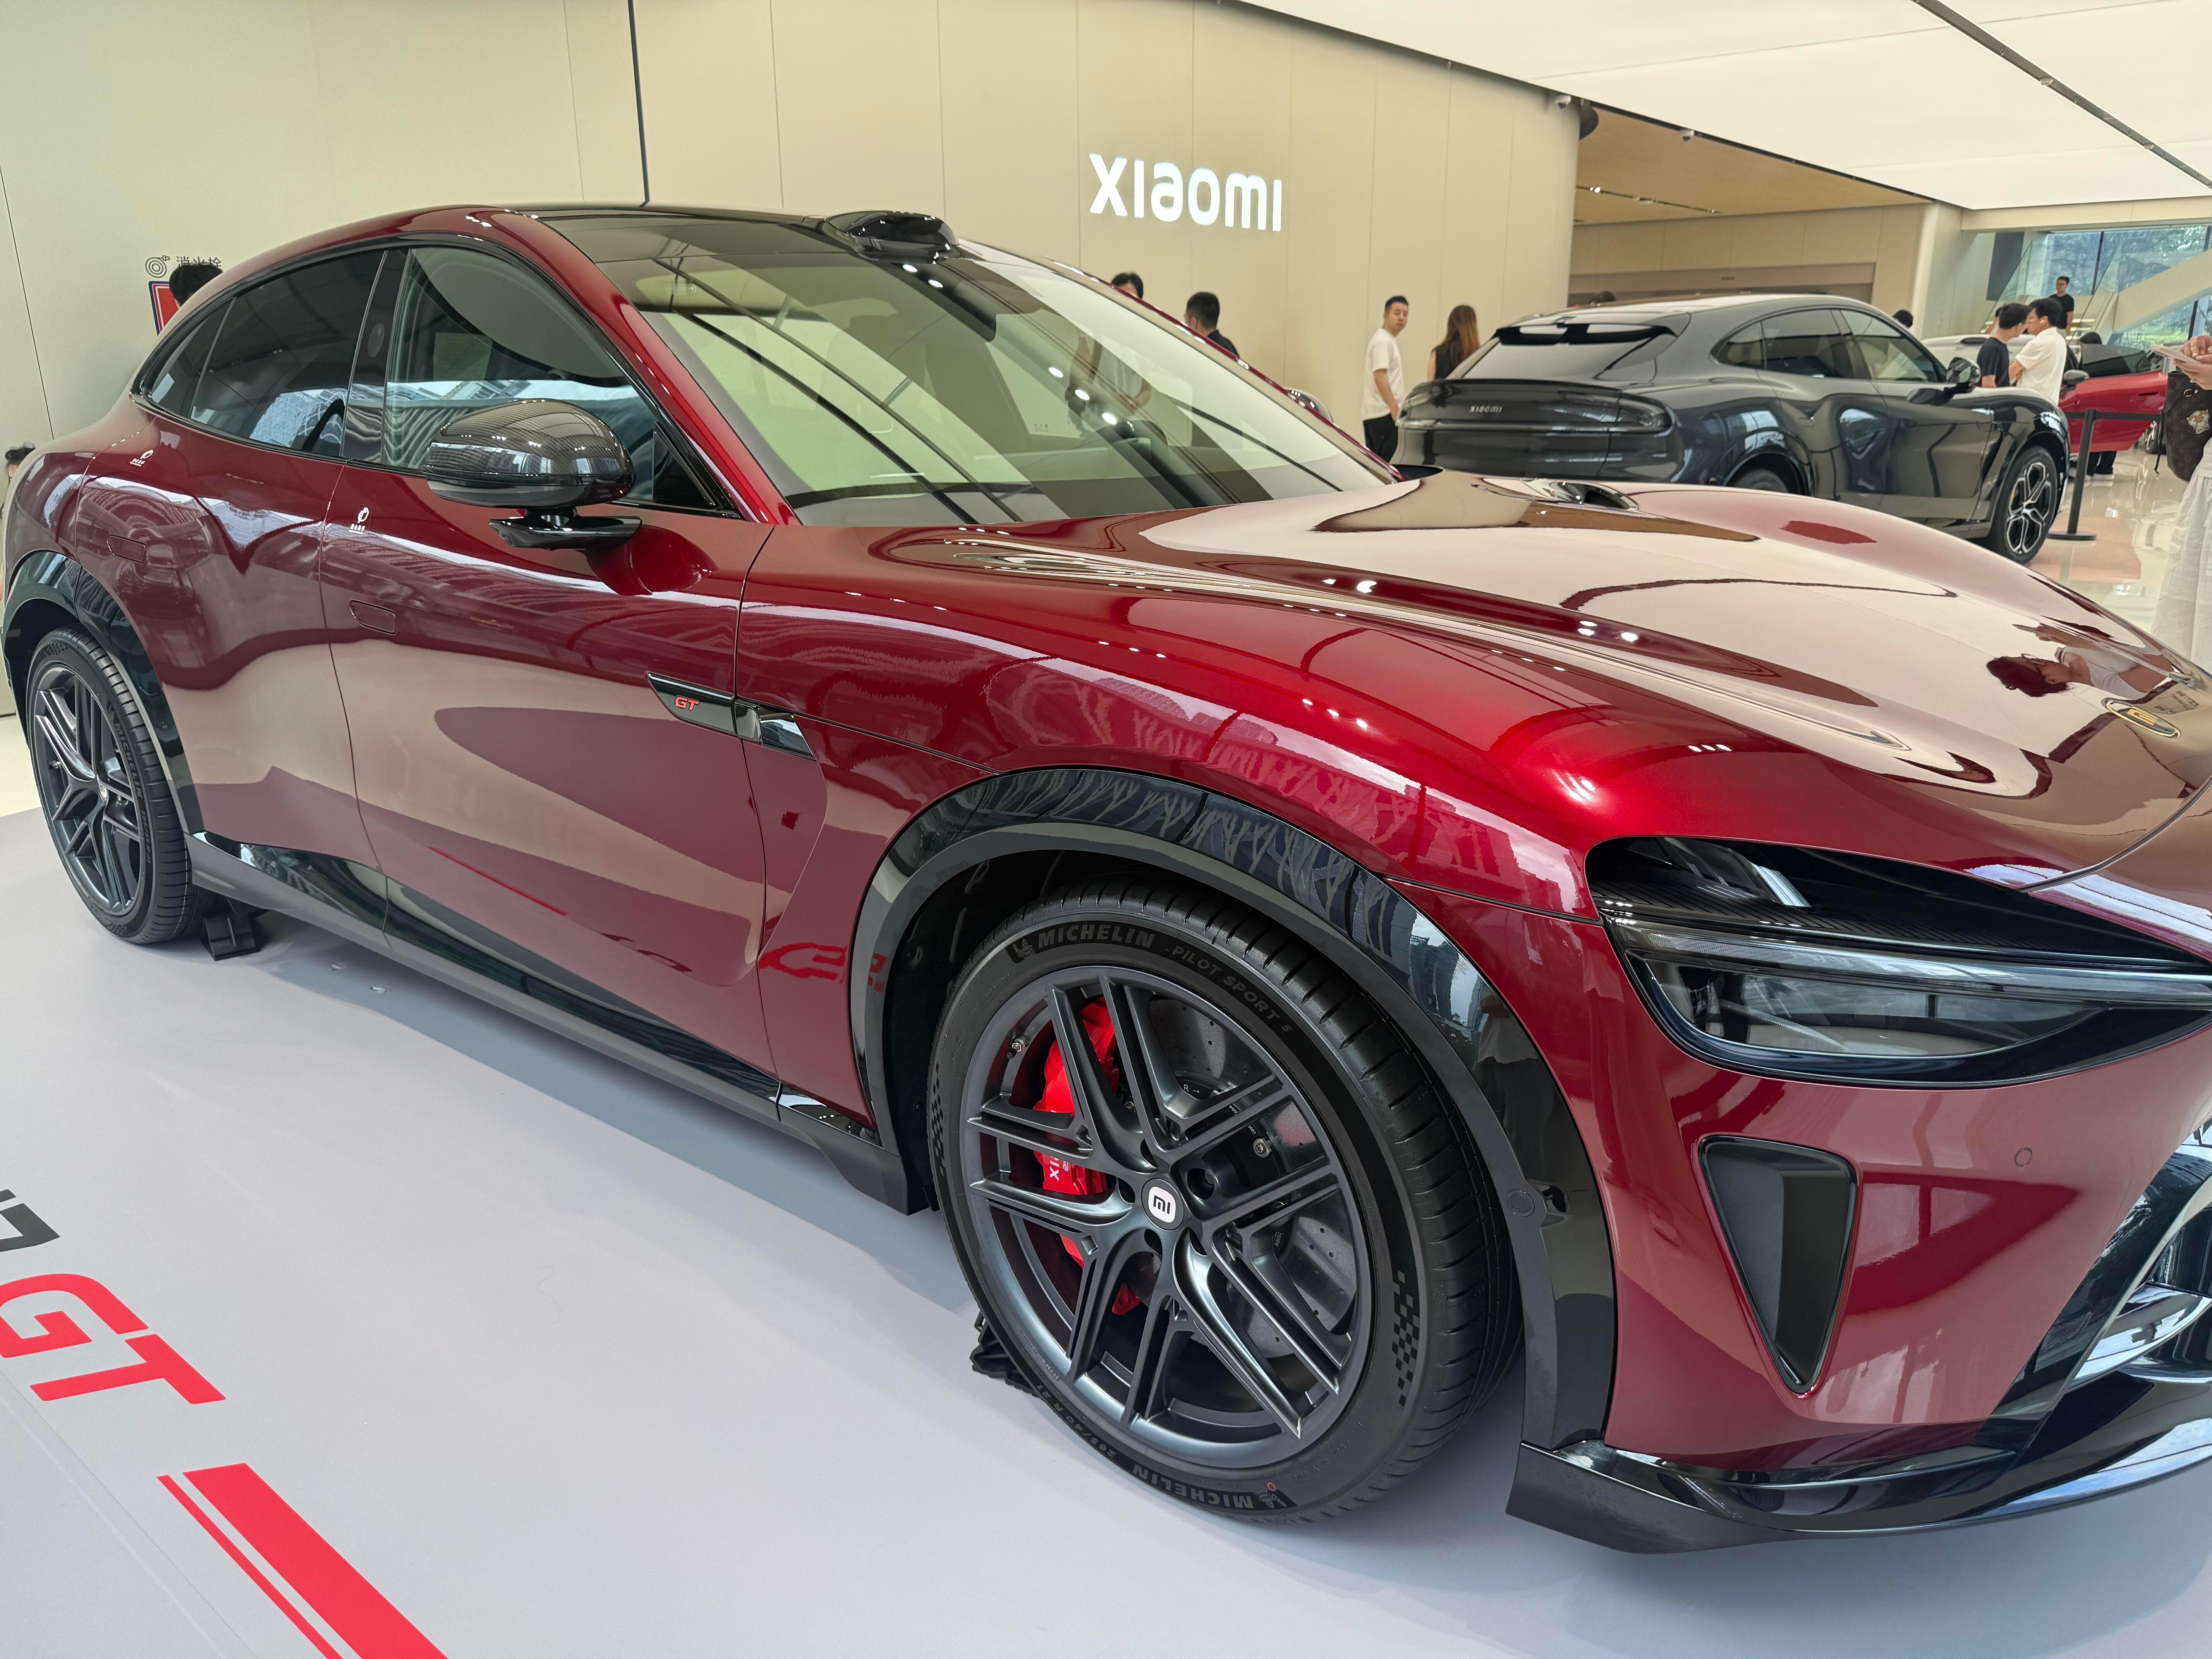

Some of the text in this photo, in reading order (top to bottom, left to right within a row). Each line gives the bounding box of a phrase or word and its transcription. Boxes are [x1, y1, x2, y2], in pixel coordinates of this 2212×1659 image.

[675, 695, 700, 711] GT
[115, 723, 143, 798] MICHELIN
[1038, 924, 1156, 949] MICHELIN
[1172, 945, 1222, 976] PILOT
[1223, 972, 1281, 1020] SPORT
[1281, 1024, 1293, 1032] 5
[1183, 1084, 1189, 1092] R
[0, 1273, 226, 1405] GT
[1036, 1385, 1051, 1398] 21
[1053, 1403, 1063, 1412] R
[1066, 1415, 1116, 1457] 265/40
[1132, 1464, 1254, 1509] MICHELIN
